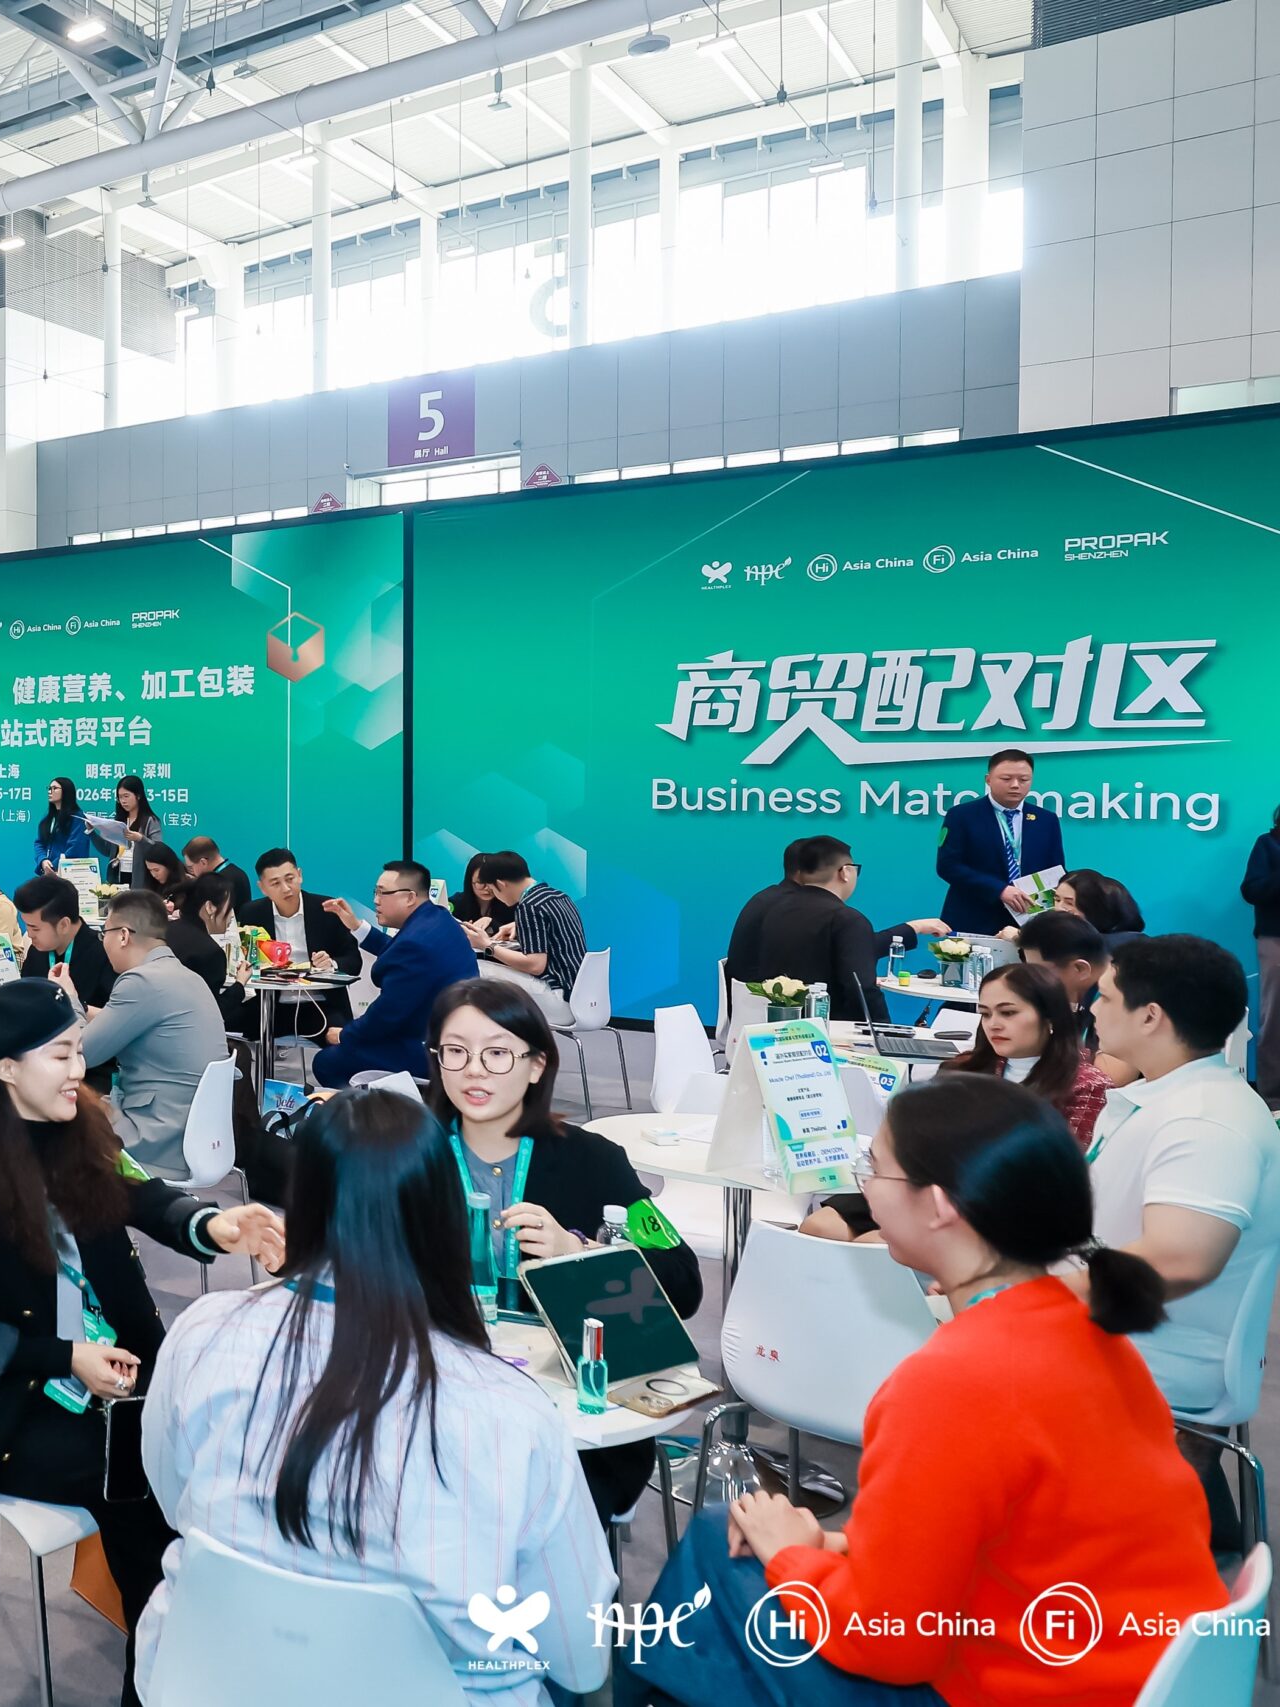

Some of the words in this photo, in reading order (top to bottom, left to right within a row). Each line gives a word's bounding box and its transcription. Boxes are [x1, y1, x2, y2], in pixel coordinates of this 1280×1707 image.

[417, 390, 446, 441] 5
[434, 446, 449, 456] Hall
[815, 562, 829, 574] Hi
[842, 560, 871, 572] Asia
[875, 557, 914, 569] China
[932, 554, 945, 565] Fi
[961, 551, 993, 563] Asia
[997, 548, 1039, 560] China
[1064, 531, 1169, 551] PROPAK
[1064, 549, 1129, 561] SHENZHEN
[26, 625, 42, 633] Asia
[42, 623, 61, 632] China
[83, 620, 99, 628] Asia
[100, 618, 120, 627] China
[131, 609, 180, 622] PROPAK
[655, 635, 1225, 766] 商贸配对区
[651, 778, 842, 815] Business
[860, 780, 1221, 831] Matcmaking
[815, 1044, 829, 1057] 02
[641, 1216, 661, 1235] 18
